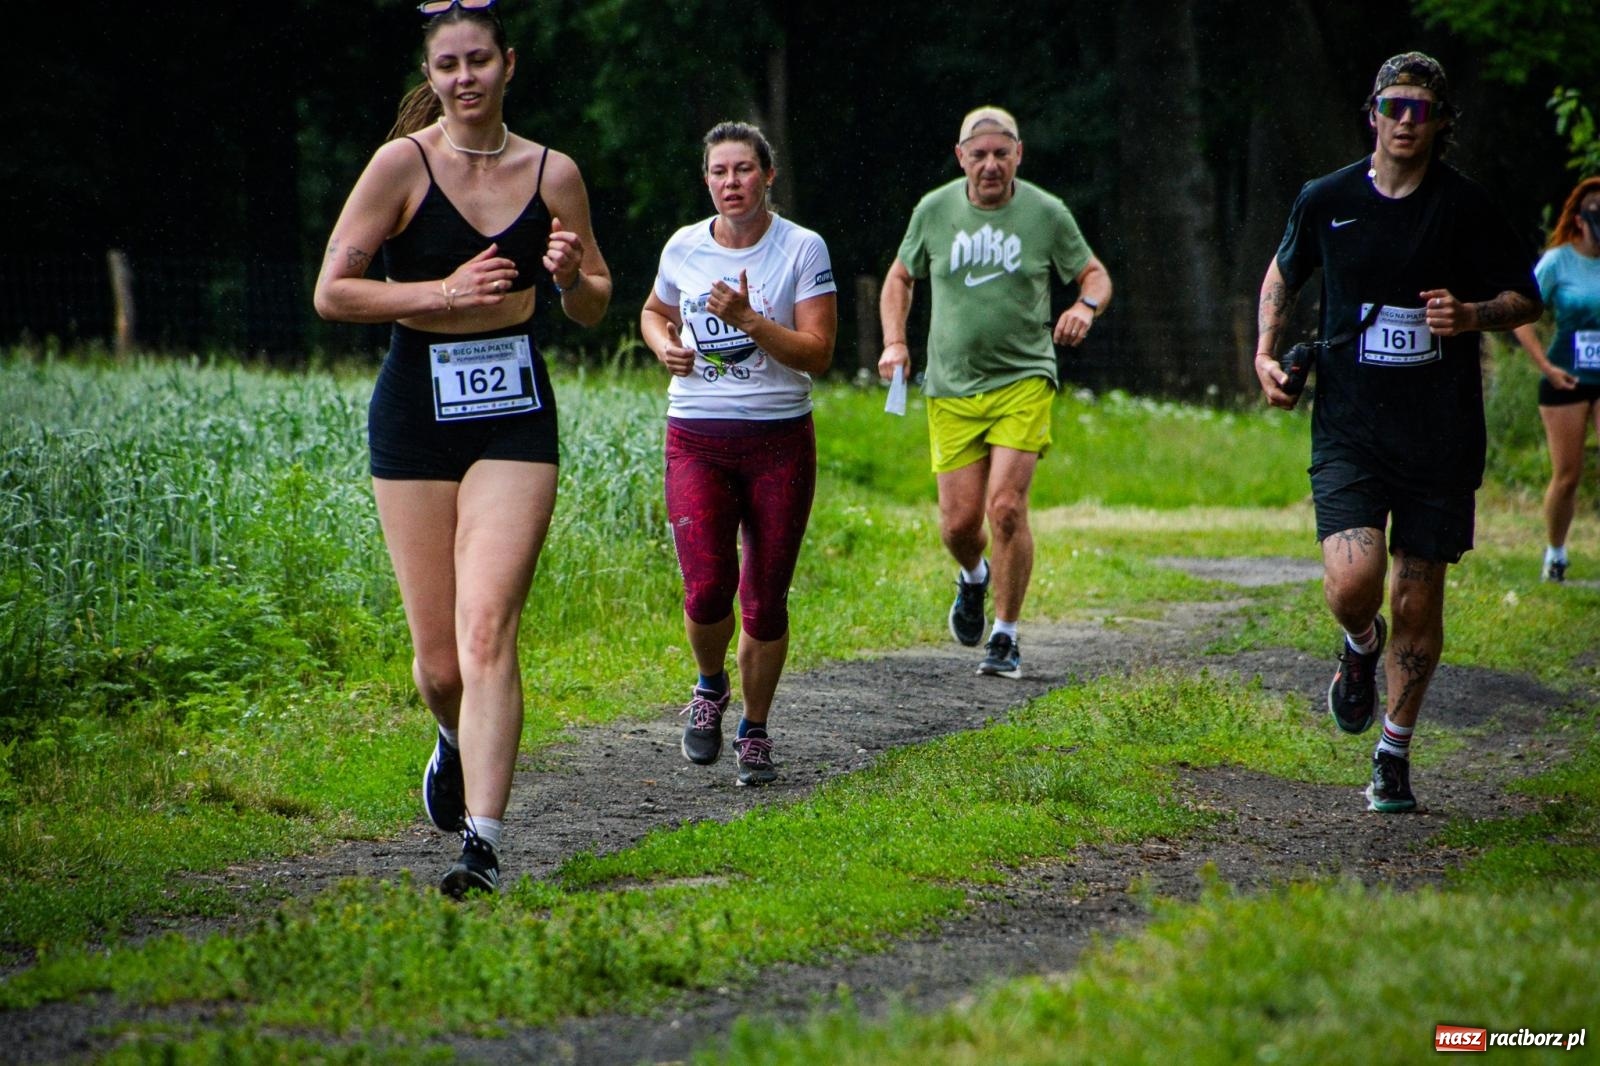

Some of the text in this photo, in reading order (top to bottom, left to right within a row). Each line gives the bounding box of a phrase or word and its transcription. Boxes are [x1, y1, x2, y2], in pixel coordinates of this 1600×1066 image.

[1382, 328, 1416, 350] 161
[453, 347, 472, 356] BIEG
[473, 346, 486, 354] NA
[456, 366, 507, 396] 162
